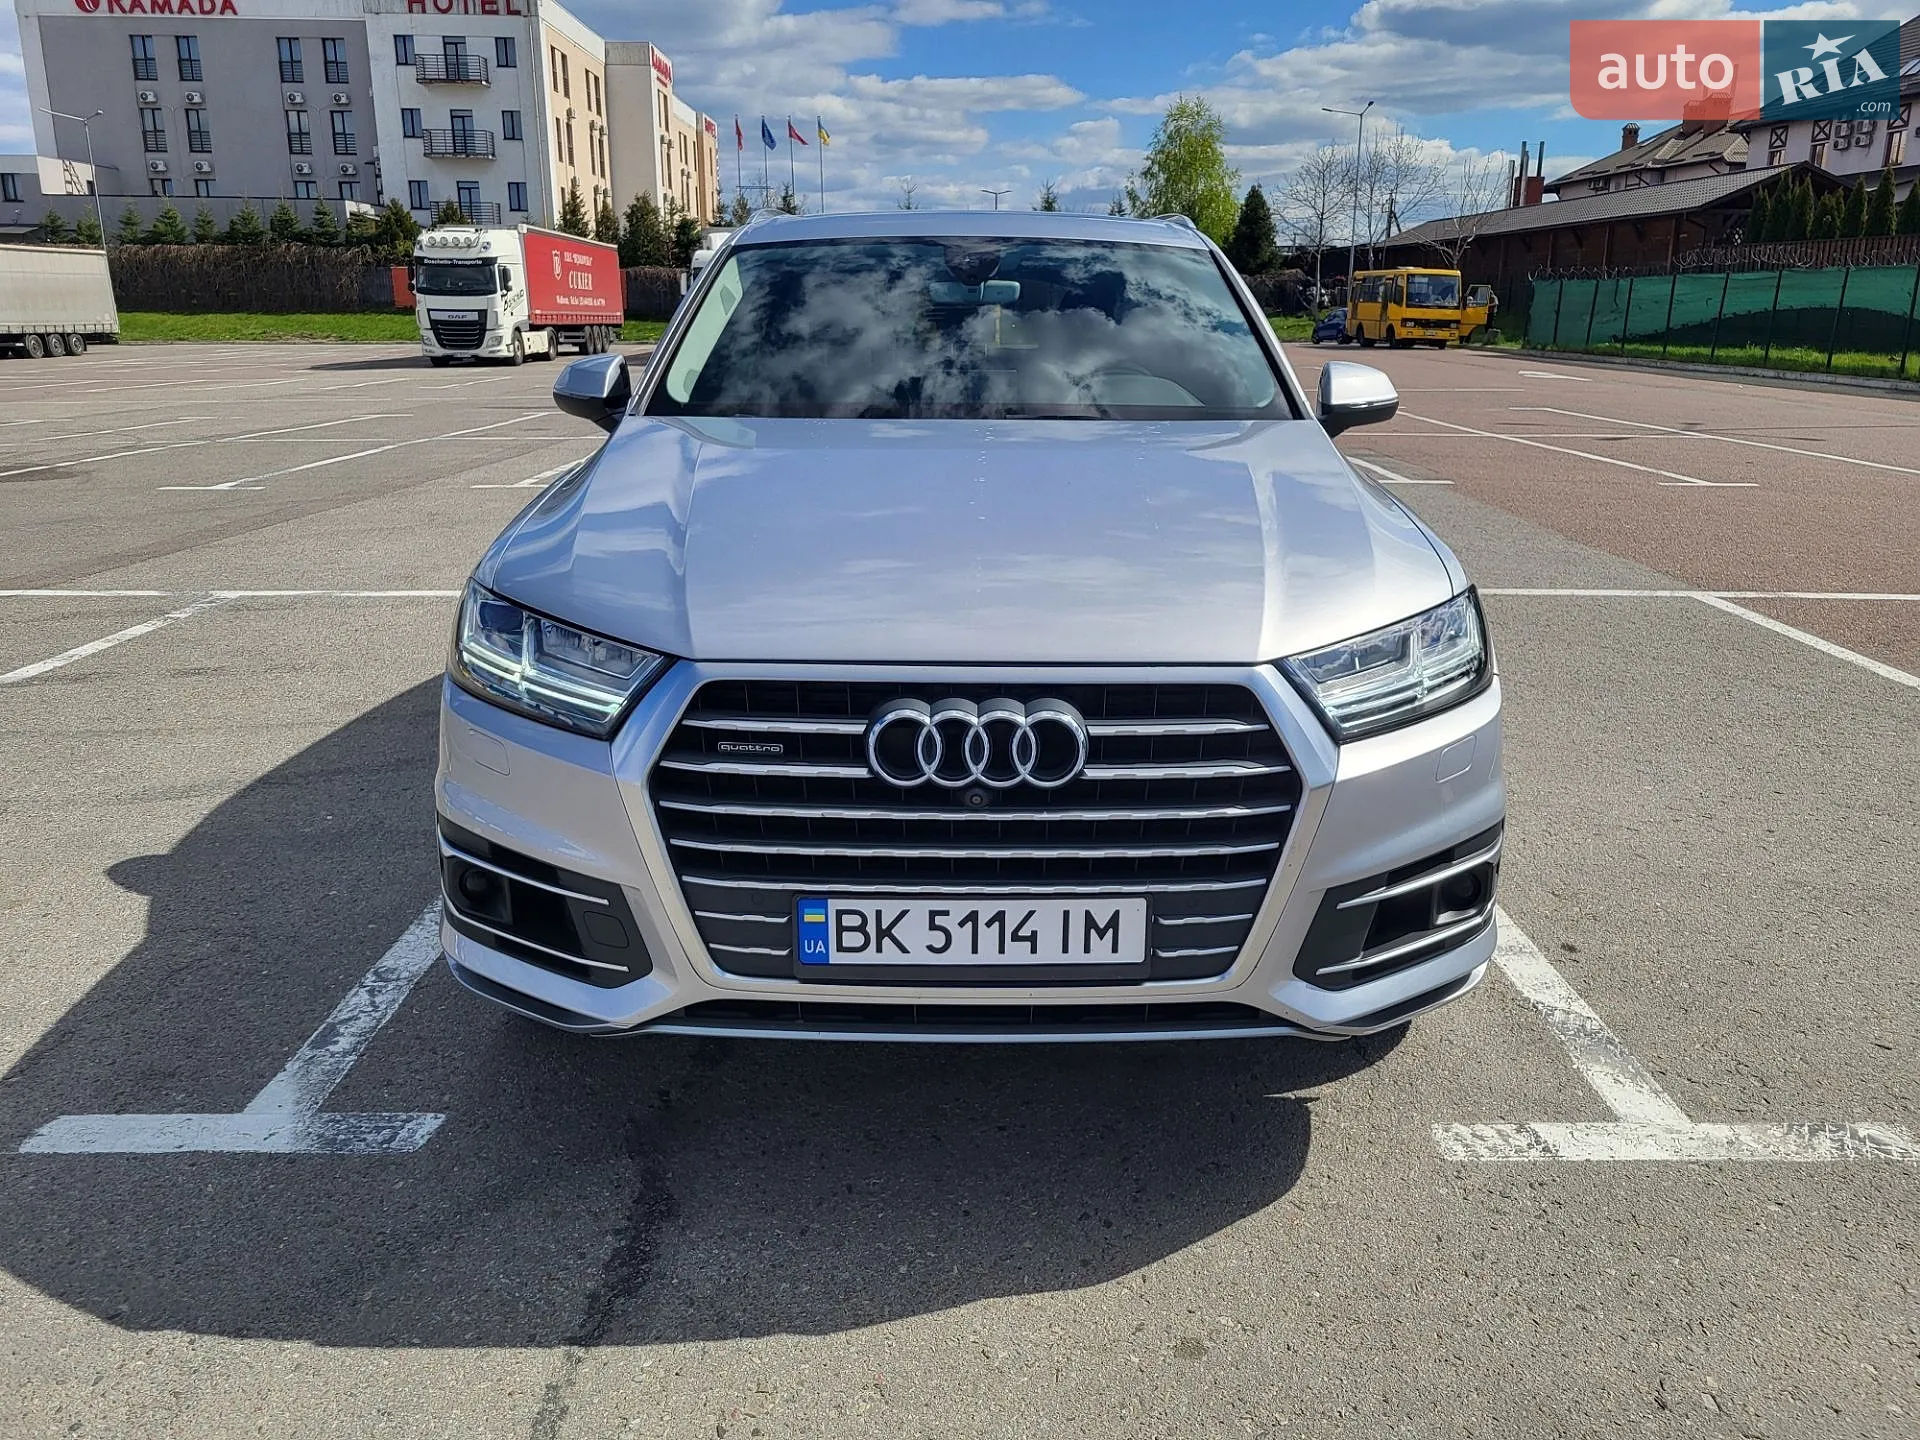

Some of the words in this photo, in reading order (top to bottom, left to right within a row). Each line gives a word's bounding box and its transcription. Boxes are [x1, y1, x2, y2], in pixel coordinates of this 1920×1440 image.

[720, 744, 780, 752] quattro
[835, 909, 911, 955] BK
[925, 909, 1038, 955] 5114
[1061, 909, 1121, 955] IM
[804, 939, 826, 954] UA
